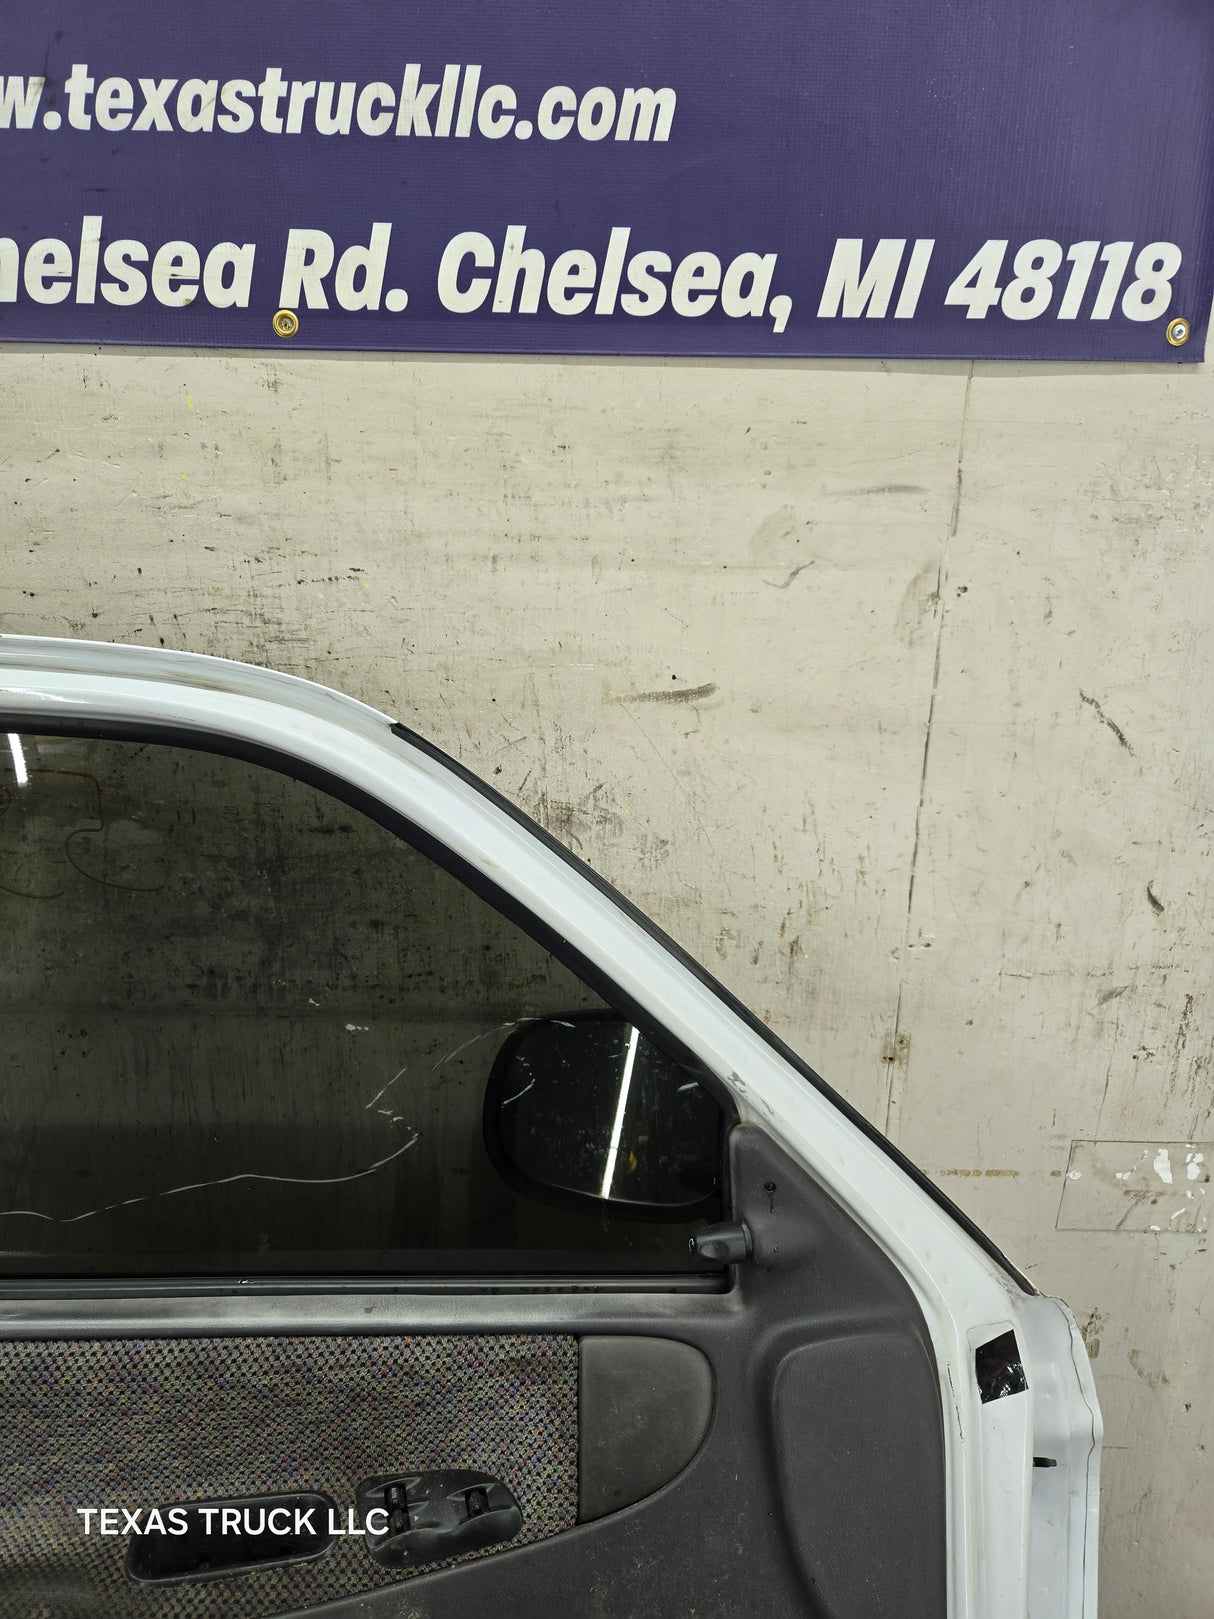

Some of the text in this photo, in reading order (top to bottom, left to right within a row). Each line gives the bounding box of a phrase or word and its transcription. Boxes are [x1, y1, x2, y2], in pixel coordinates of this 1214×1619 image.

[0, 63, 677, 142] w.texastruckllc.com
[279, 222, 409, 312] Rd.
[437, 224, 793, 333] Chelsea,
[817, 238, 936, 319] MI
[944, 239, 1183, 322] 48118
